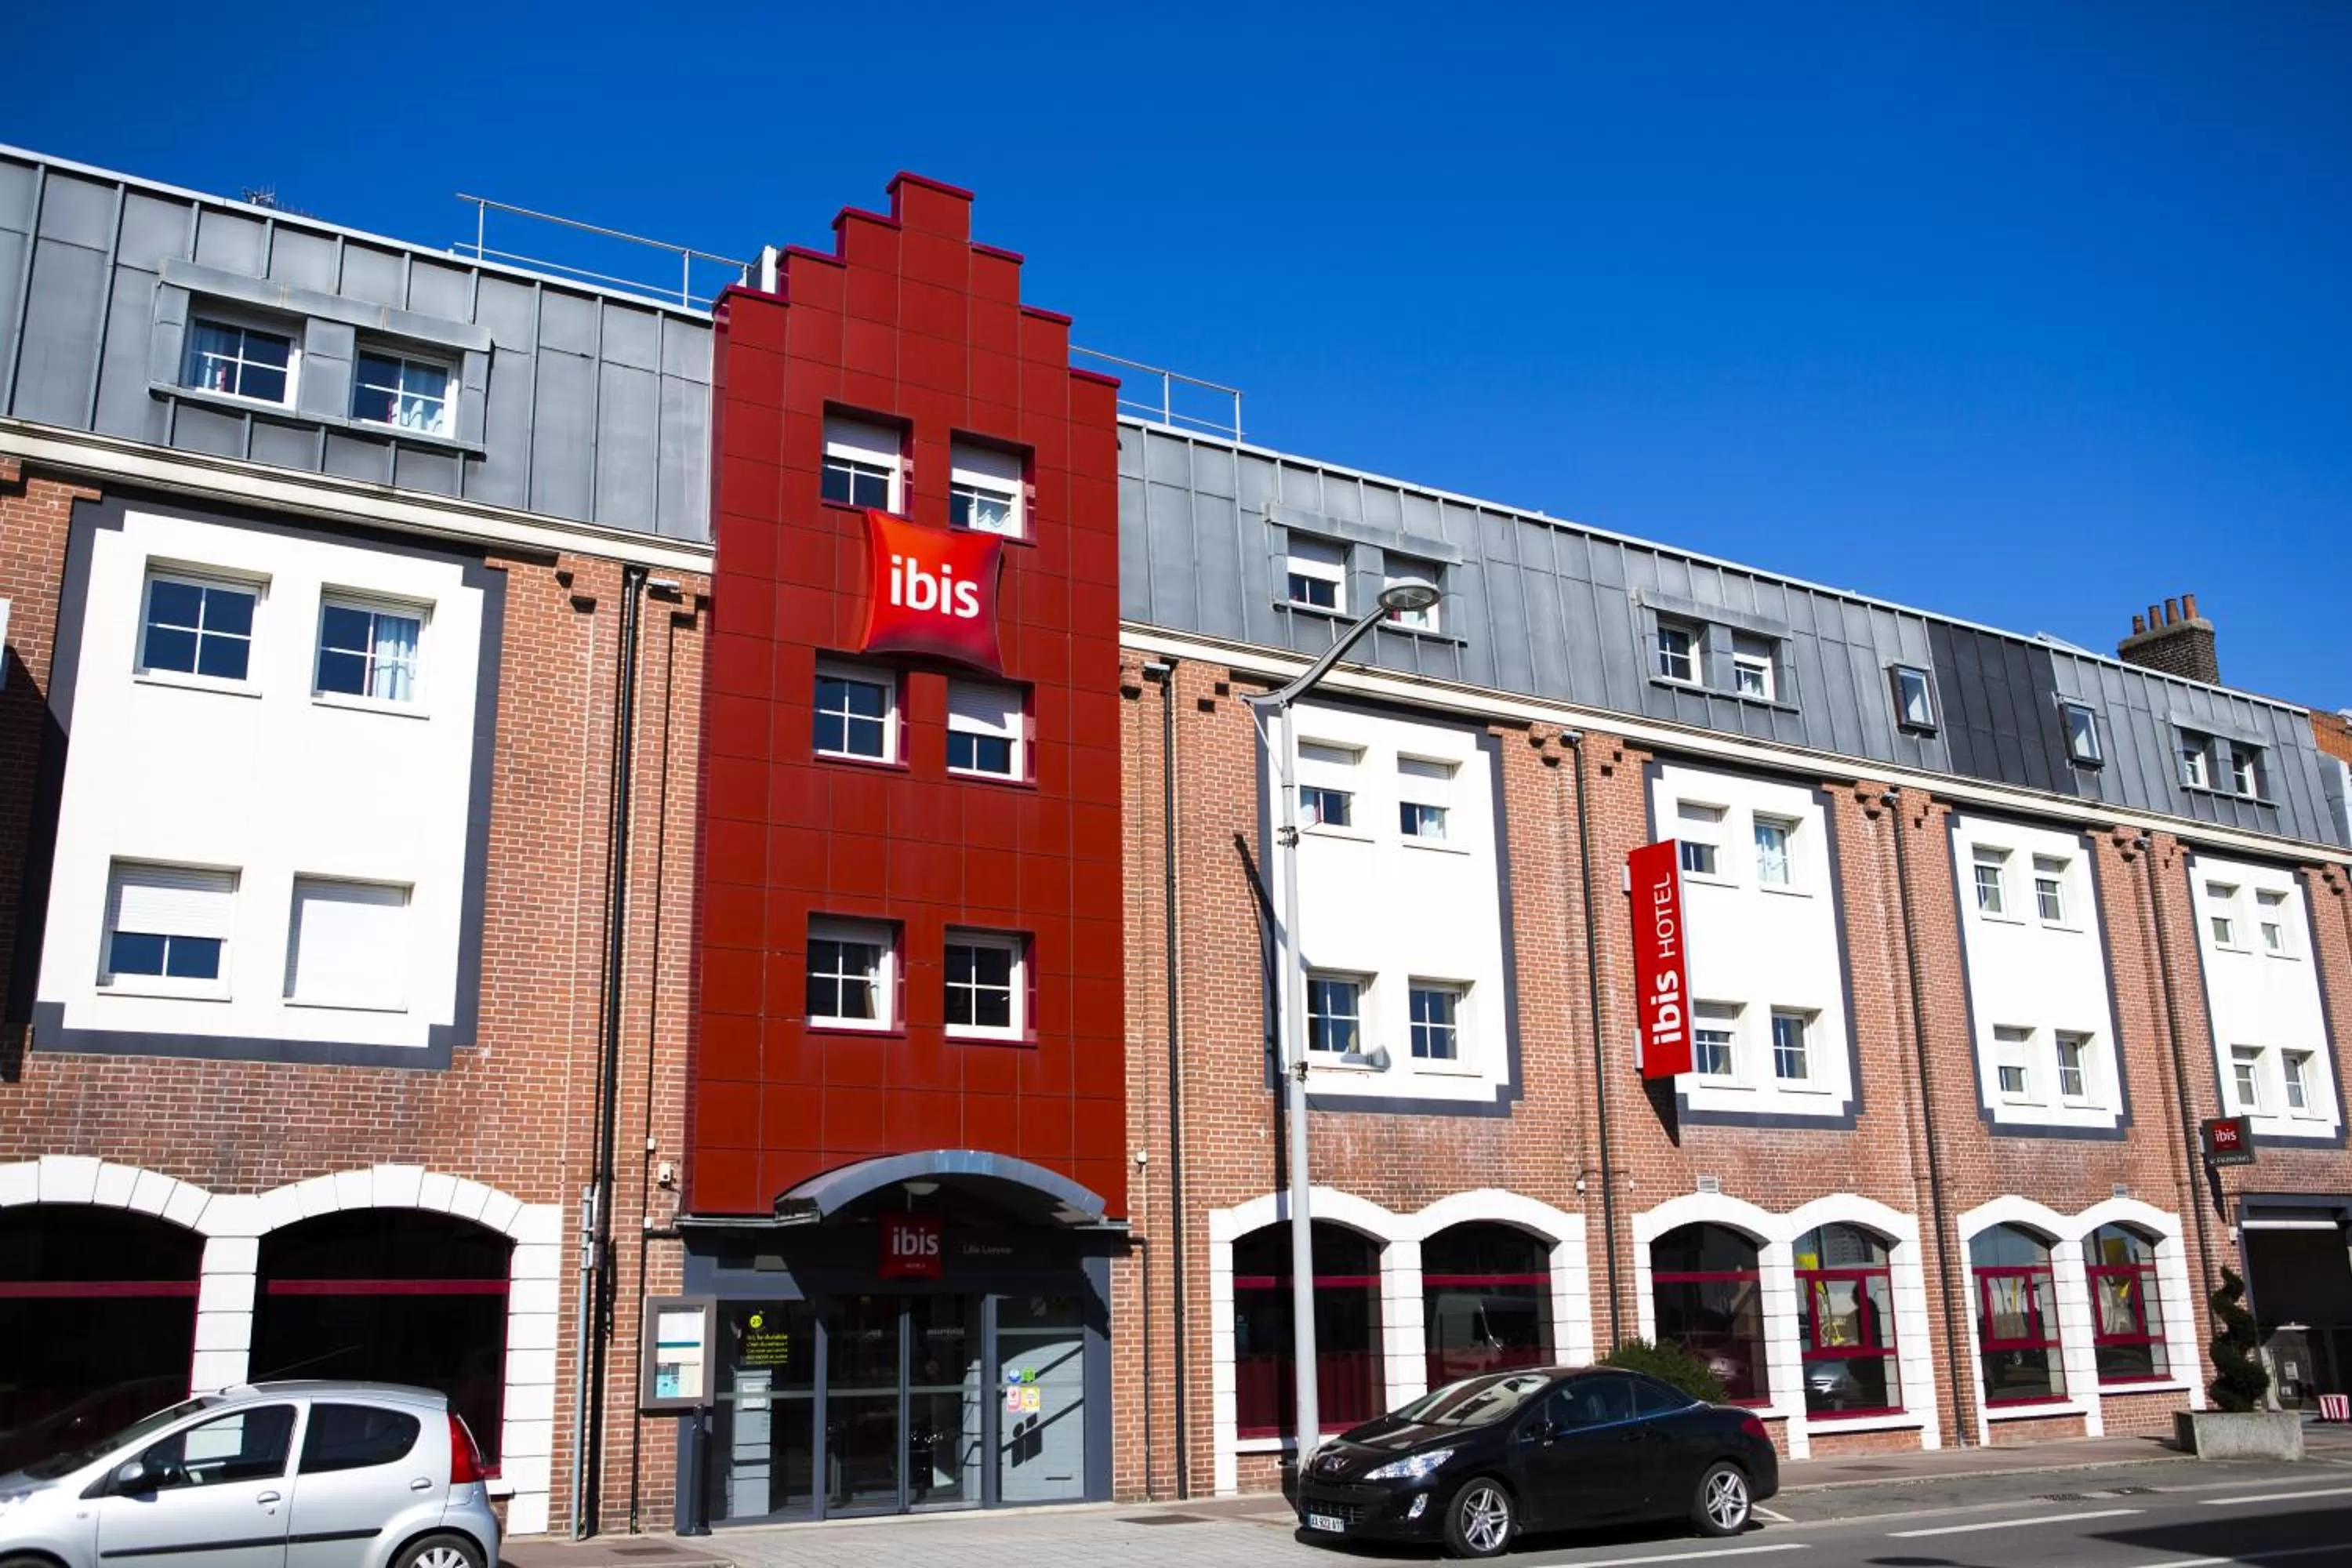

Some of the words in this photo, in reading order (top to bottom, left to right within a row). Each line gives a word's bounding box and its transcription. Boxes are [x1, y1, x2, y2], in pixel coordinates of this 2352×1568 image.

[891, 554, 979, 619] ibis
[1653, 872, 1675, 958] HOTEL
[1650, 970, 1682, 1045] ibis
[2214, 1128, 2237, 1142] ibis
[892, 1226, 938, 1255] ibis
